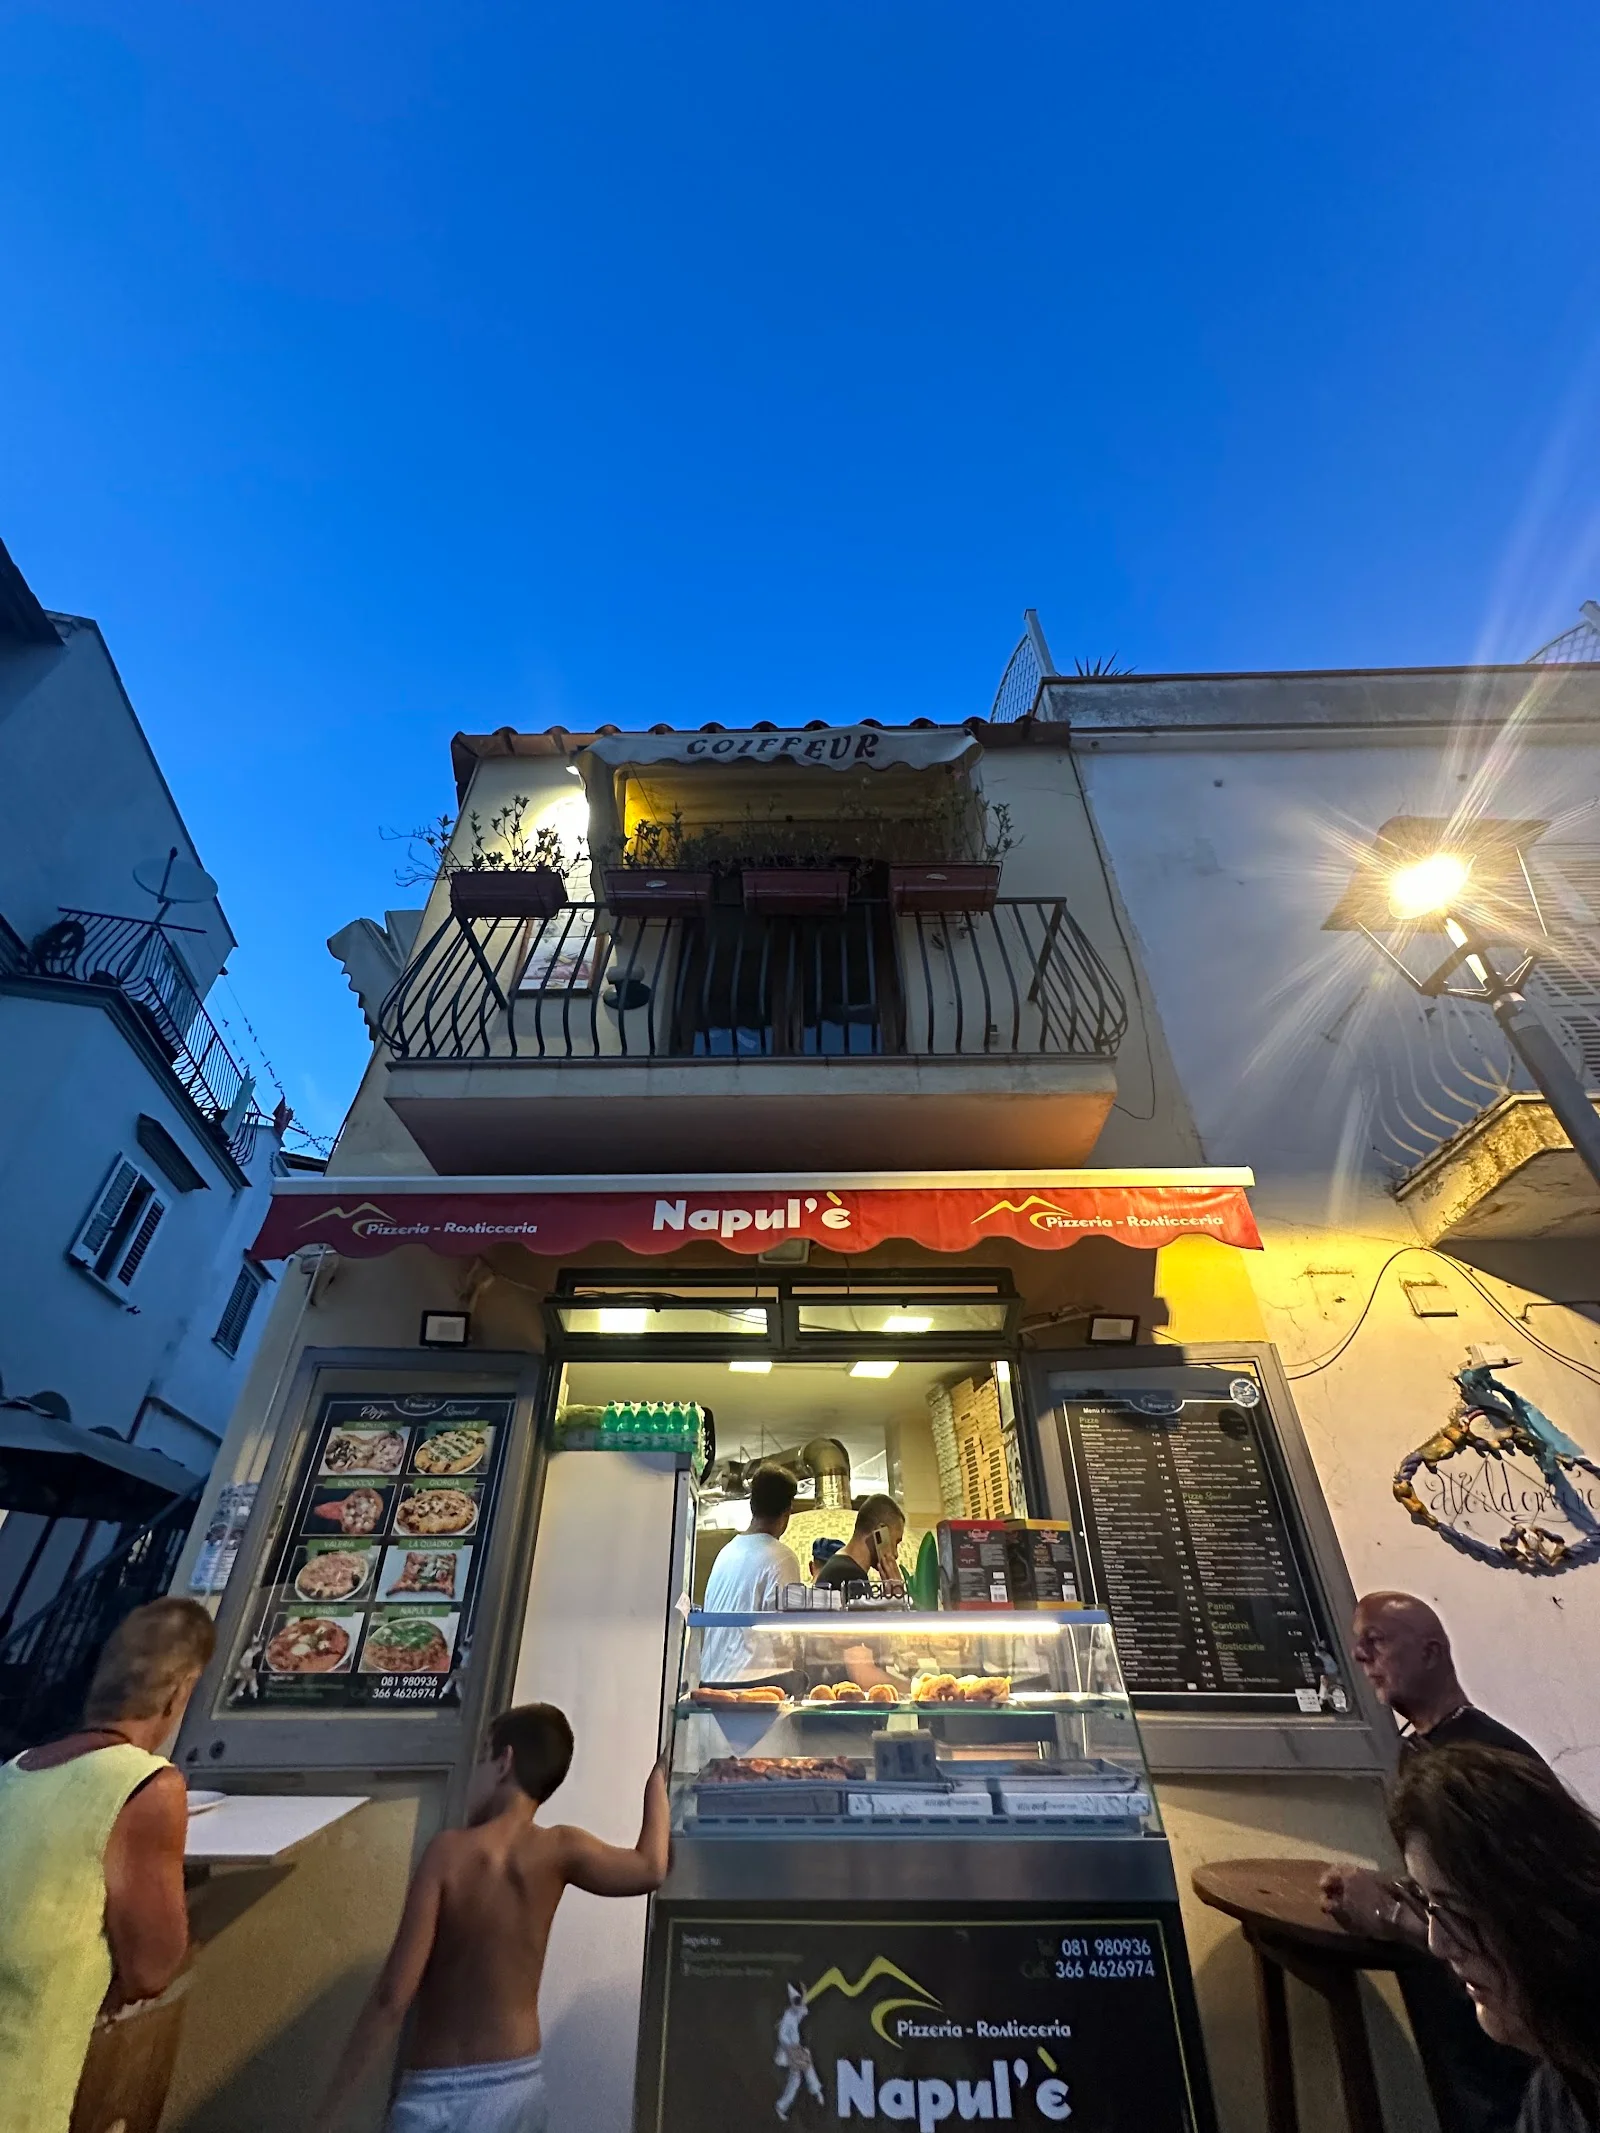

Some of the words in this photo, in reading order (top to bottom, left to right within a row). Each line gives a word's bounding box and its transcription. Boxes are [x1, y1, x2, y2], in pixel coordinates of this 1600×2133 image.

[687, 733, 879, 760] COIFFEUR
[366, 1223, 430, 1235] Pizzeria
[444, 1221, 538, 1234] Rosticceria
[1046, 1217, 1113, 1228] Pizzeria
[1128, 1214, 1224, 1227] Rosticceria
[408, 1540, 419, 1548] LA
[381, 1676, 399, 1687] 081
[402, 1676, 438, 1687] 980936
[372, 1688, 391, 1699] 366
[393, 1688, 436, 1699] 4626974
[1061, 1938, 1089, 1956] 081
[1094, 1938, 1152, 1956] 980936
[1055, 1959, 1085, 1979] 366
[1088, 1959, 1155, 1979] 4626974
[897, 2019, 963, 2038] Pizzeria
[977, 2019, 1072, 2038] Rosticceria
[836, 2045, 1073, 2133] Napul'è
